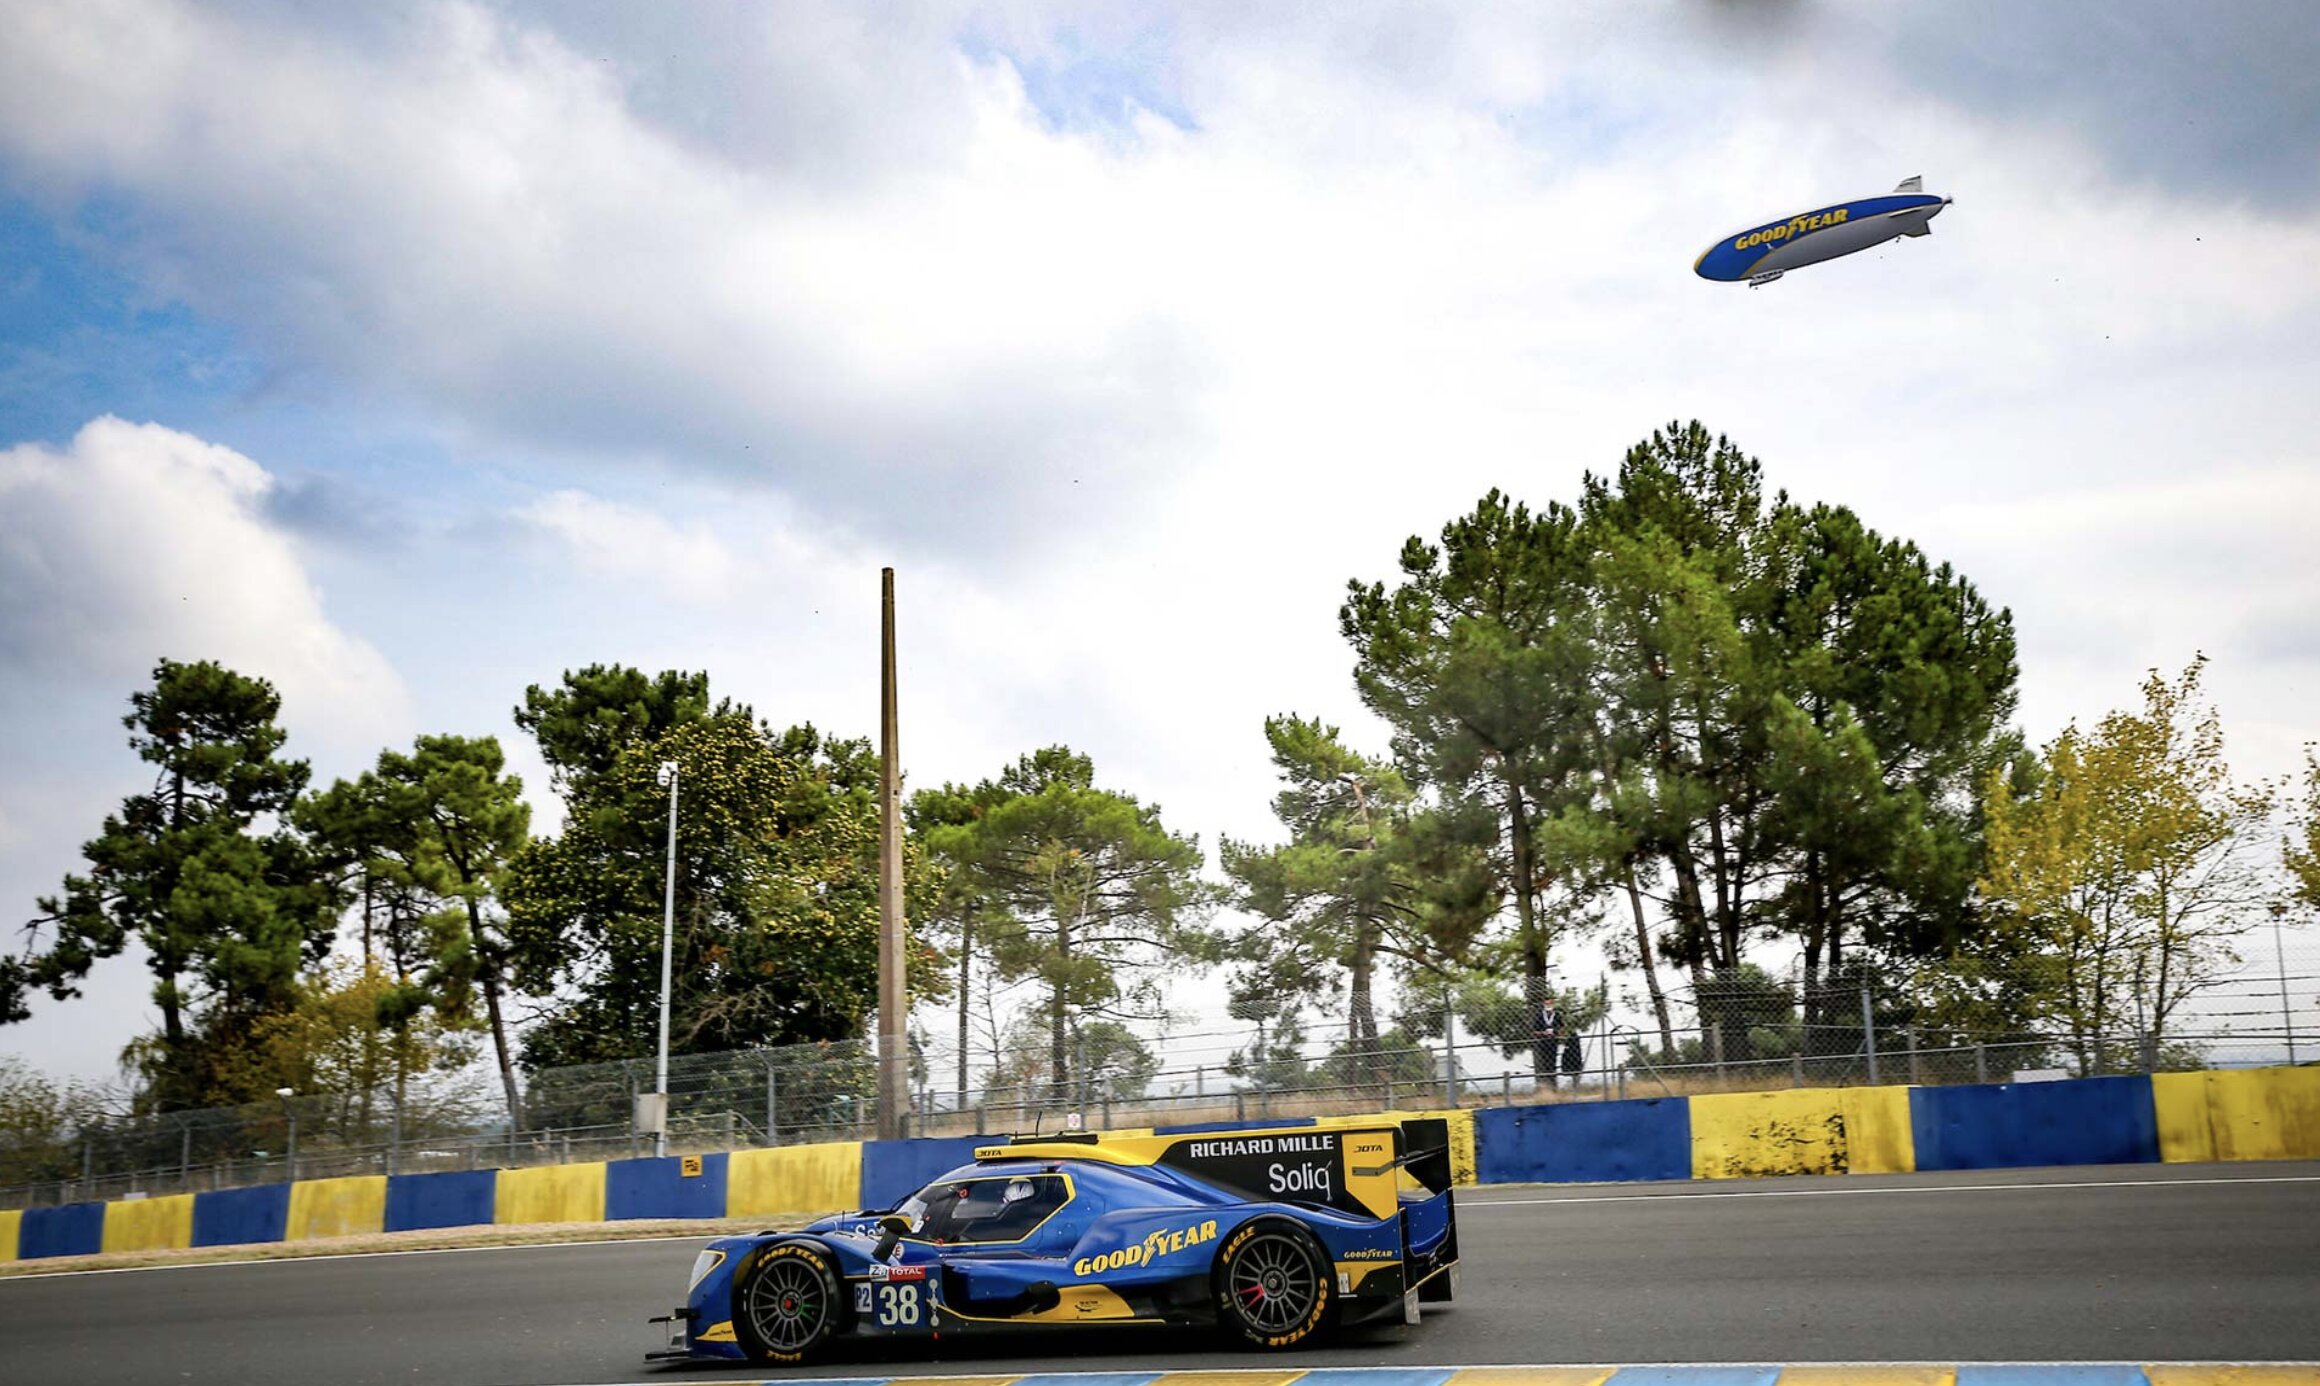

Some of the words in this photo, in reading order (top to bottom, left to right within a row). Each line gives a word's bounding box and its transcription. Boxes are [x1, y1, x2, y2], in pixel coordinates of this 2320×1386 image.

[1735, 208, 1848, 250] GOODYEAR
[1190, 1139, 1273, 1158] RICHARD
[1278, 1135, 1334, 1153] MILLE
[758, 1247, 824, 1270] GOODYEAR
[1074, 1220, 1217, 1276] GOODYEAR
[1223, 1226, 1256, 1264] EAGLE
[1344, 1248, 1393, 1259] GOODYEAR
[891, 1267, 922, 1276] TOTAL
[856, 1286, 870, 1308] P2
[879, 1285, 919, 1326] 38
[1268, 1278, 1328, 1346] GOODYEAR
